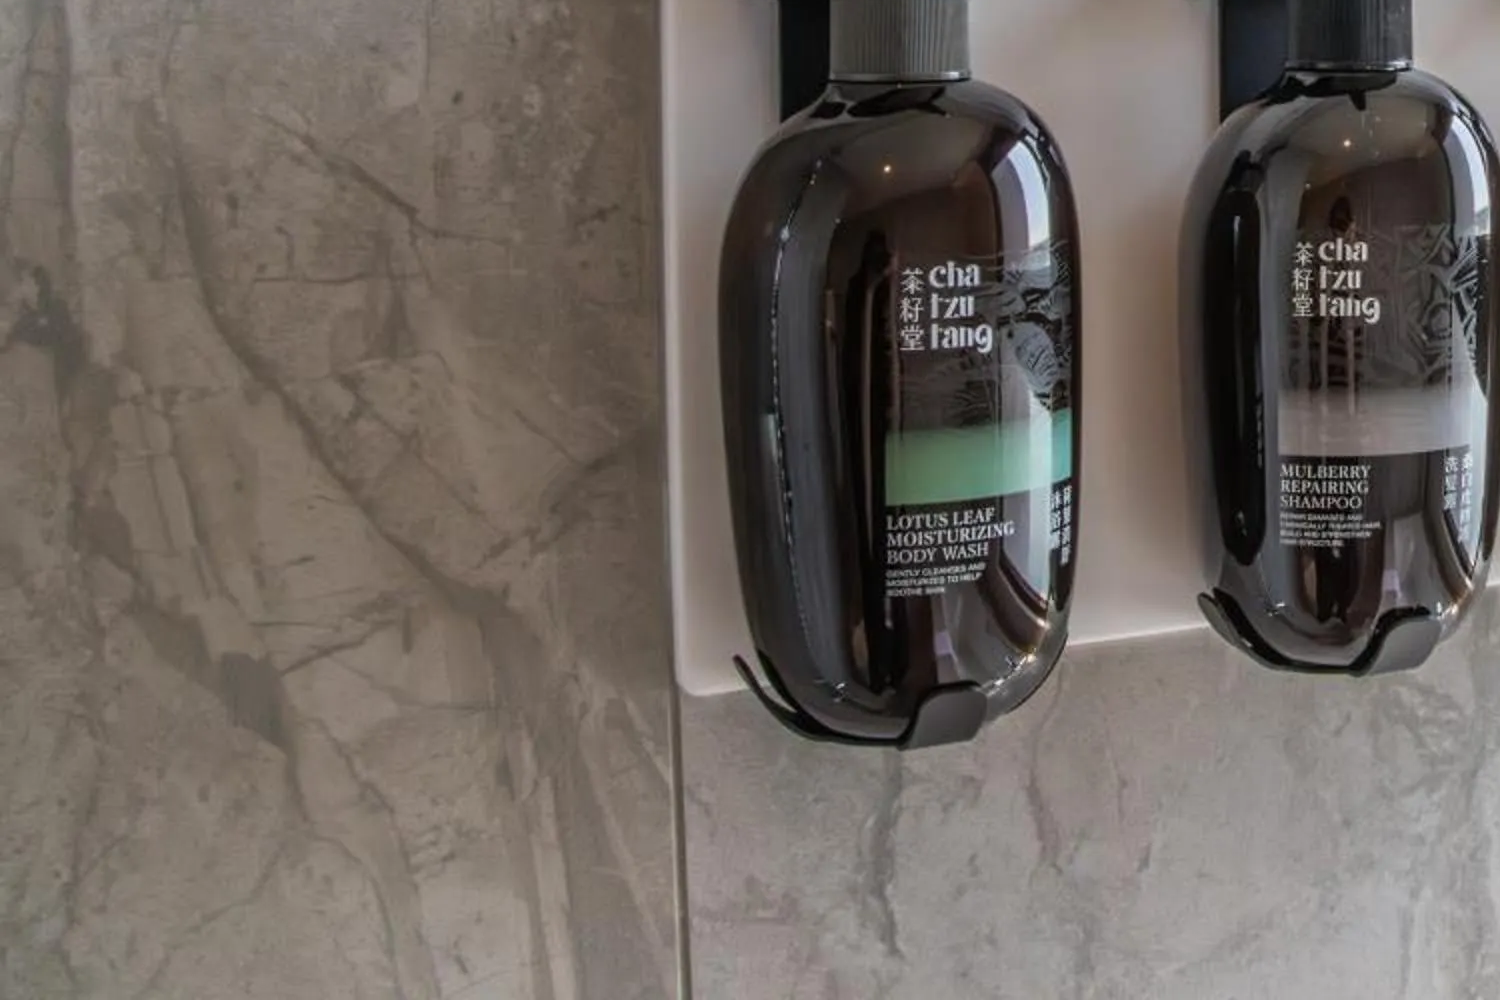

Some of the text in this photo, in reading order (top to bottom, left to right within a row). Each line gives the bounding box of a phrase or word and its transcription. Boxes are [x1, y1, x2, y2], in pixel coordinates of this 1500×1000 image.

[1318, 237, 1368, 263] cha
[929, 260, 980, 288] cha
[1280, 464, 1371, 479] MULBERRY
[1280, 480, 1369, 494] REPAIRING
[1280, 495, 1362, 509] SHAMPOO
[886, 507, 995, 531] LOTUS LEAF
[886, 521, 1015, 547] MOISTURIZING
[886, 542, 989, 565] BODY WASH
